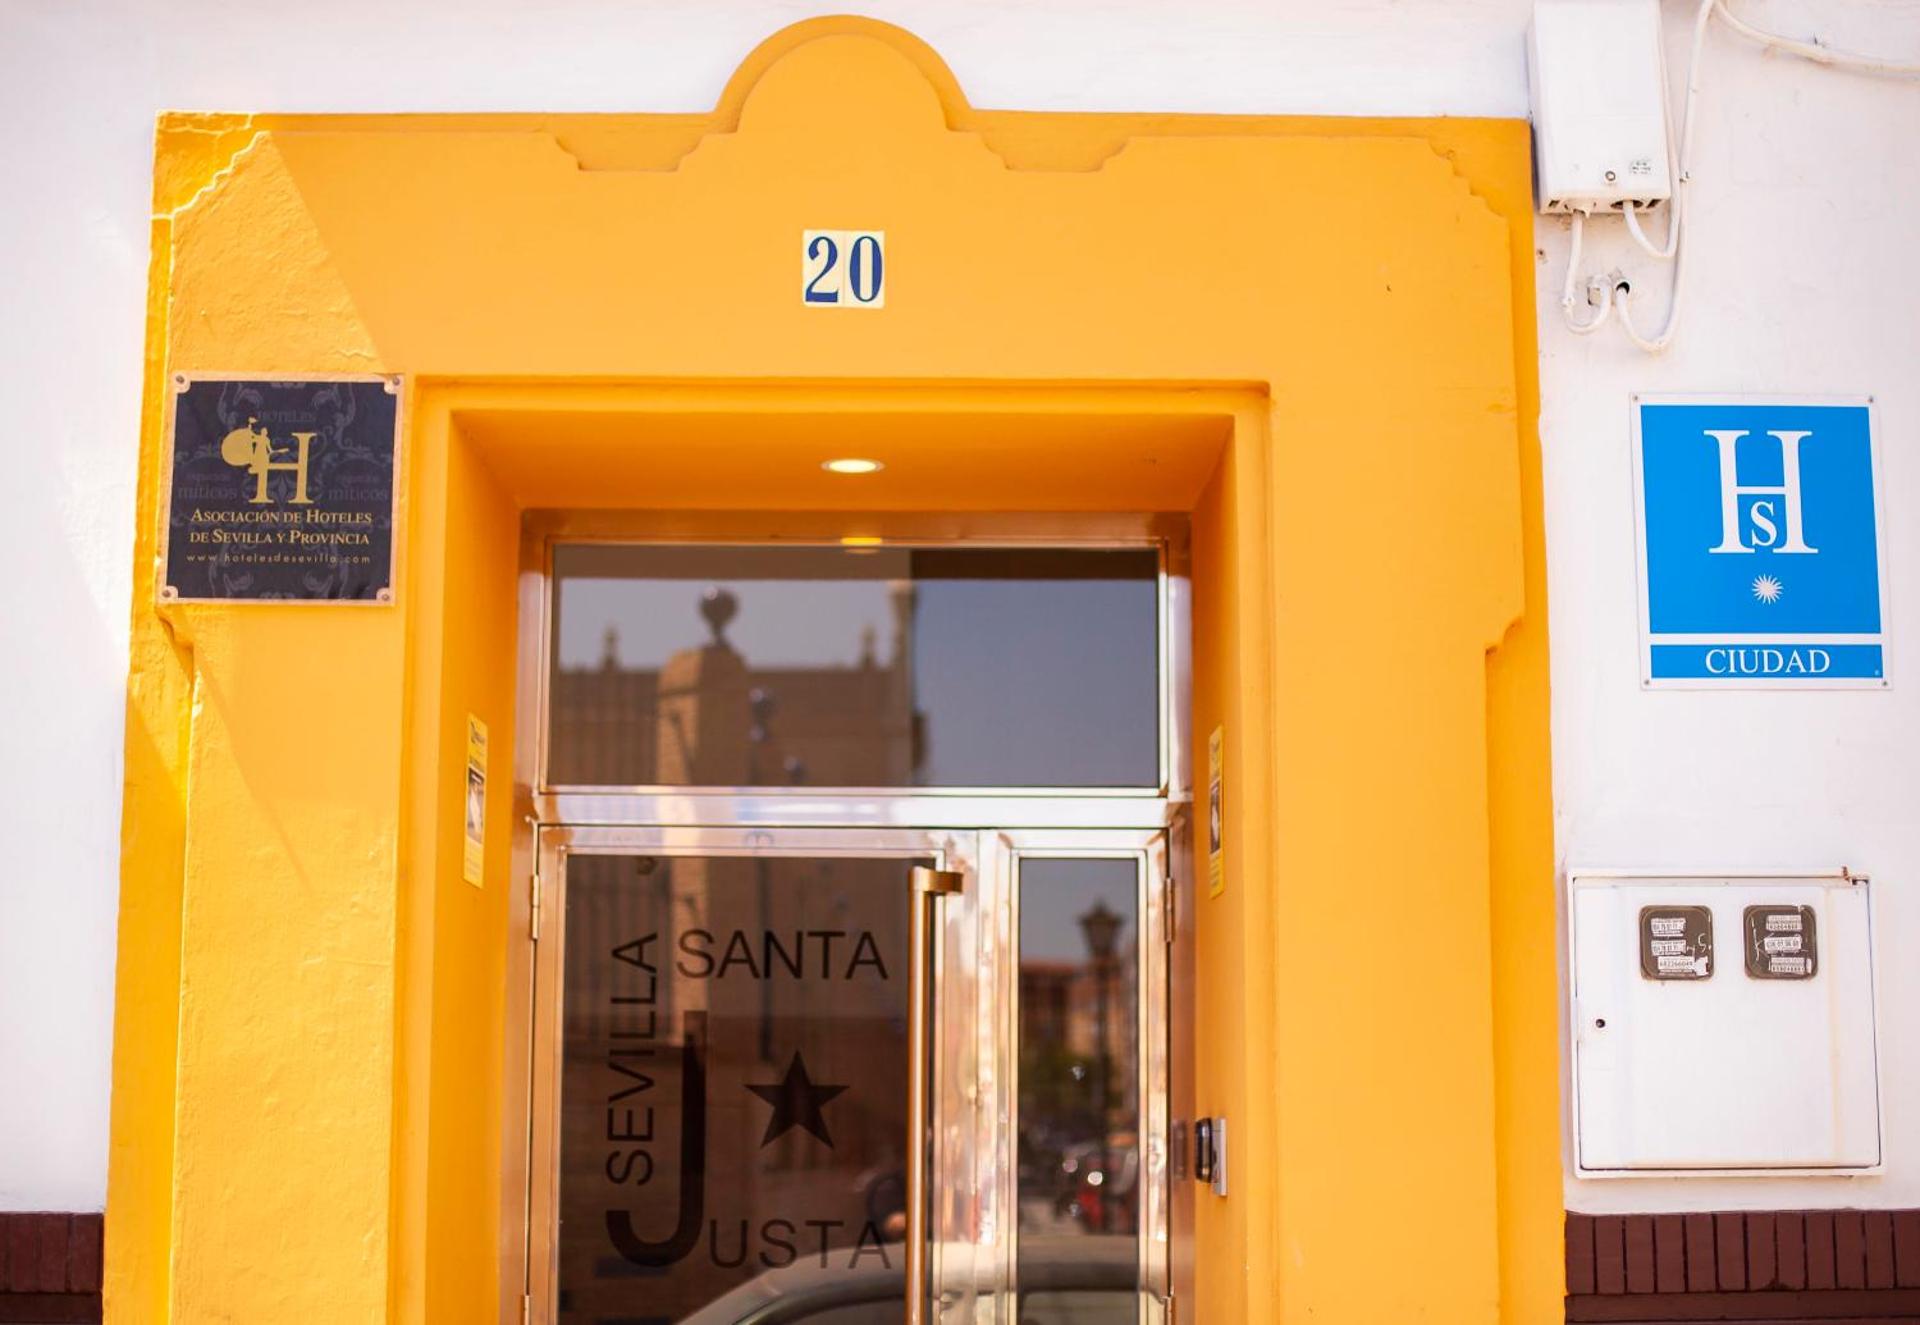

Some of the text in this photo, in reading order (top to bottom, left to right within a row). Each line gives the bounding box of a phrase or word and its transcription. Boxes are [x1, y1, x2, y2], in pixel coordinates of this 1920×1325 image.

[804, 235, 883, 303] 20
[283, 511, 301, 524] DE
[306, 509, 373, 524] HOTELES
[190, 529, 370, 545] DE SEVILLA Y PROVINCIA
[1705, 649, 1831, 674] CIUDAD
[677, 929, 888, 979] SANTA
[606, 932, 657, 1186] SEVILLA
